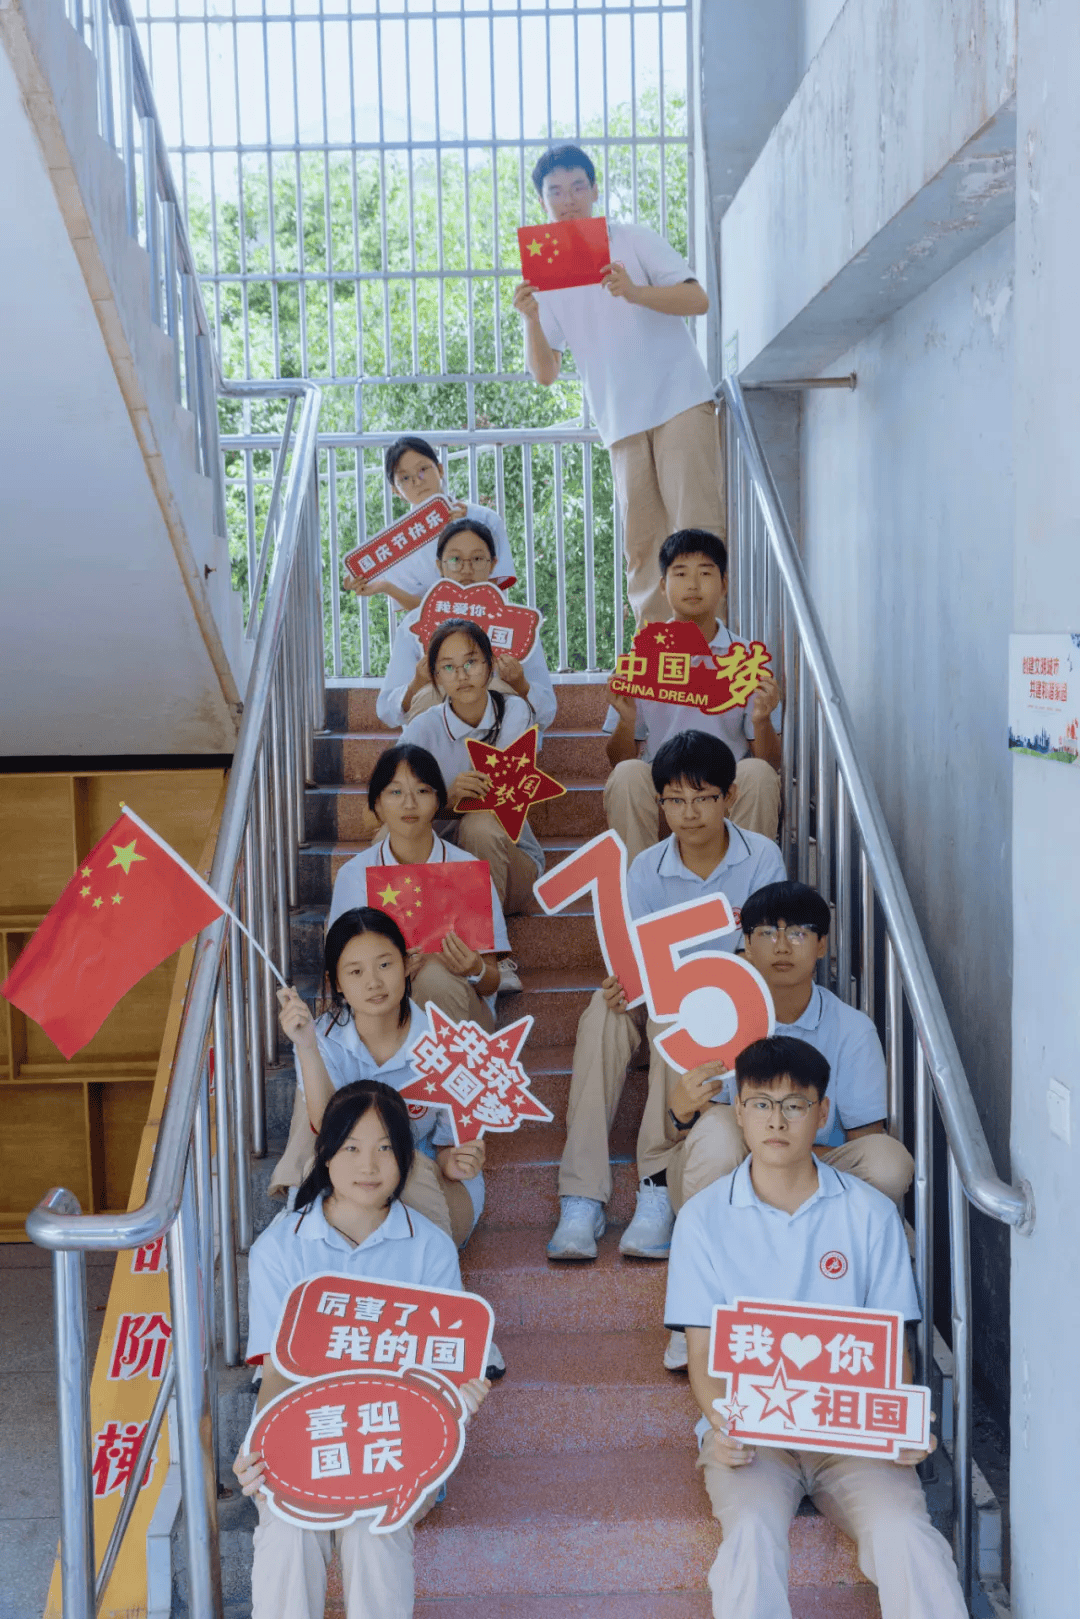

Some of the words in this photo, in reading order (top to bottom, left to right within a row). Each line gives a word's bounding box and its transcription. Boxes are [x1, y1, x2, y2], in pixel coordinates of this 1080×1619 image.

[357, 509, 444, 573] 国庆节快乐
[435, 600, 487, 617] 我爱你
[611, 679, 655, 698] CHINA
[658, 688, 709, 706] DREAM
[615, 644, 773, 713] 中国梦
[536, 834, 771, 1074] 75
[416, 1040, 515, 1125] 中国梦
[316, 1291, 419, 1327] 厉害了
[325, 1326, 465, 1373] 我的国
[305, 1400, 401, 1440] 喜迎
[811, 1385, 909, 1436] 祖国
[310, 1438, 404, 1480] 国庆
